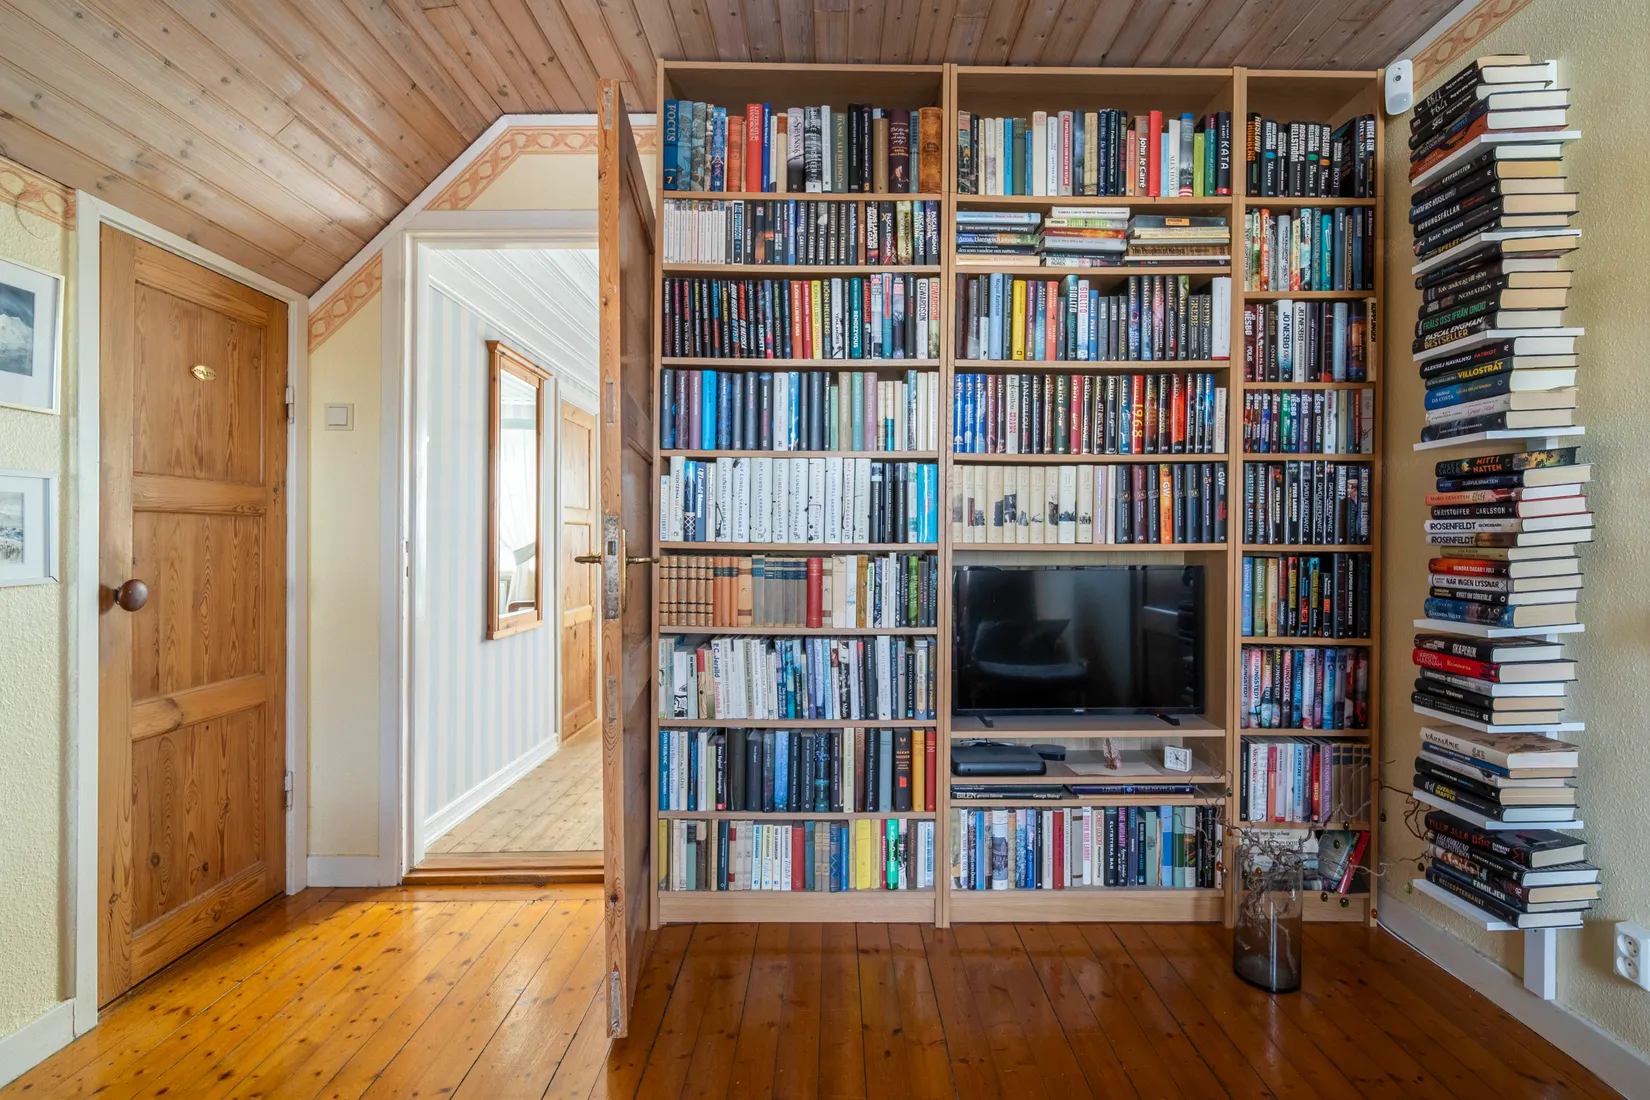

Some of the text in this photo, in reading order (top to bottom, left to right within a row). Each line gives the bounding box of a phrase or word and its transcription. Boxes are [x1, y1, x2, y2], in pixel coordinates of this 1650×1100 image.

[667, 104, 677, 141] FOCUS
[1247, 121, 1255, 161] THUNBERG
[1290, 124, 1299, 161] HELLSTRÖM
[1322, 127, 1330, 157] ROSLUND
[1139, 137, 1147, 188] John le Carré
[1220, 140, 1229, 169] KATA
[1417, 204, 1460, 231] HONUNGSFÄLLAN
[1428, 222, 1464, 242] Kate Morton
[931, 281, 939, 320] EDWARDSON
[1069, 286, 1077, 313] GIOLITO
[1080, 286, 1088, 313] GIOLITO
[1458, 284, 1492, 300] NOMADEN
[823, 281, 831, 334] BJÖRN HELLBERG
[1283, 312, 1290, 322] JO
[1298, 306, 1304, 316] JO
[1440, 301, 1486, 324] OSS ONDO
[1244, 311, 1252, 335] NESBØ
[1425, 316, 1484, 341] PASCAL ENGMAN
[1424, 329, 1468, 349] BESTSELLER
[1424, 362, 1445, 372] ALEKSEJ
[1457, 361, 1503, 379] VILLOSTRÅT
[1021, 381, 1029, 428] JAN GUILLOU
[1132, 403, 1143, 438] 1968
[1218, 472, 1225, 486] GW
[1338, 466, 1346, 496] SMIRNOFF
[1473, 464, 1502, 473] NATTEN
[1163, 481, 1170, 497] GW
[1457, 578, 1474, 586] INGEN
[1474, 580, 1500, 588] LYSSNAR
[1416, 656, 1443, 668] HANNAH
[1118, 822, 1126, 847] MORIARTY
[1473, 879, 1506, 901] FAMILJEN
